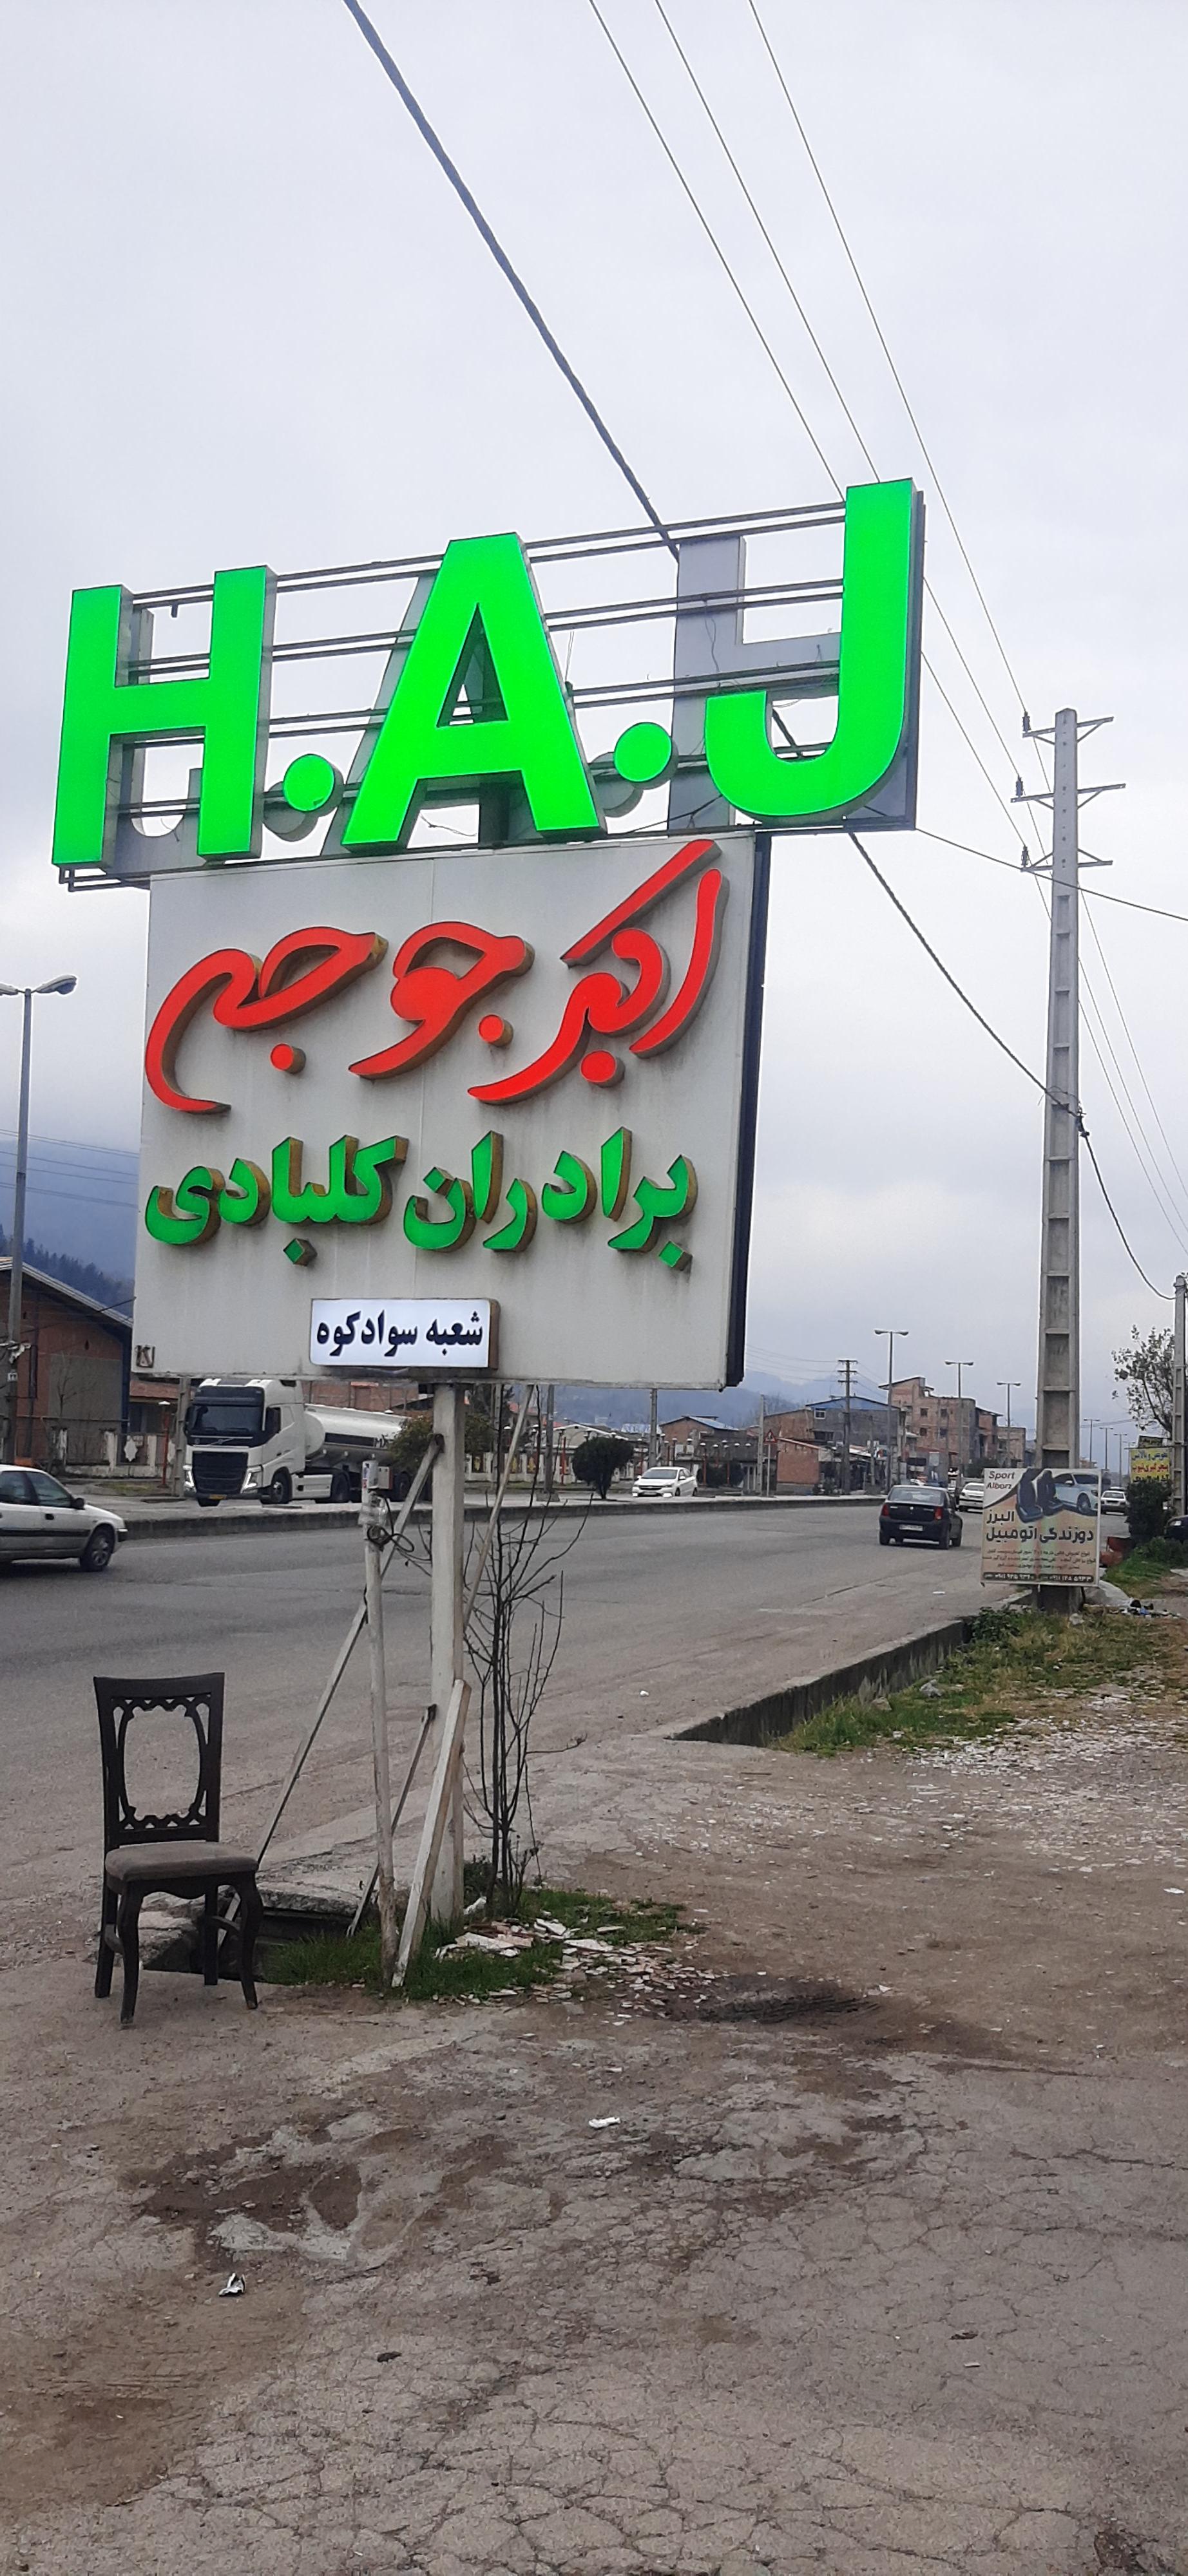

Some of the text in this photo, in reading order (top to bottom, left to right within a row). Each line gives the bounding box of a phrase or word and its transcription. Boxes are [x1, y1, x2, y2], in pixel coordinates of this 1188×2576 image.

[52, 480, 912, 866] H.A.J
[146, 840, 727, 1112] اکبر جوجه
[145, 1128, 696, 1269] برادران کلبادی
[316, 1309, 483, 1357] شعبه سوادکوه
[988, 1470, 1015, 1481] Sport
[986, 1510, 1014, 1525] البرز
[986, 1525, 1094, 1544] دوزندگی اتومبیل
